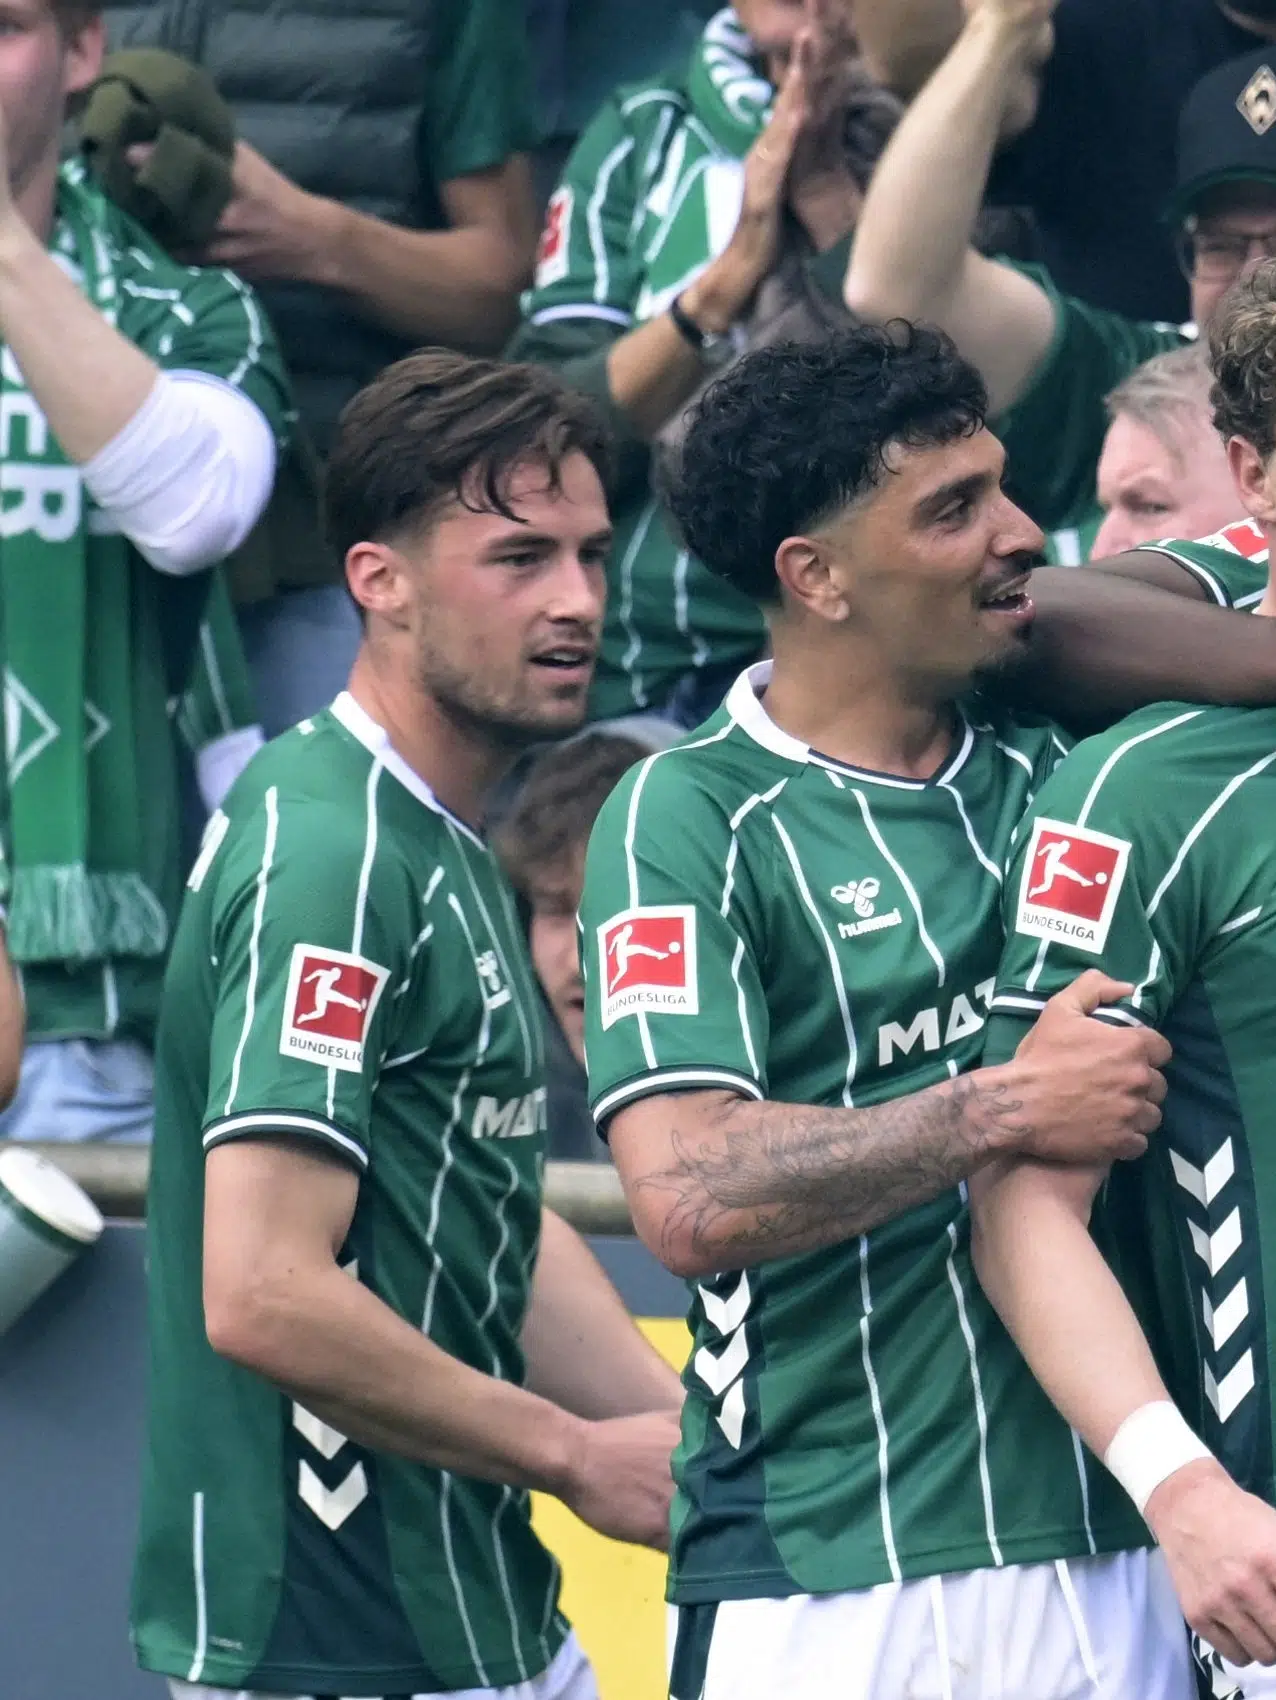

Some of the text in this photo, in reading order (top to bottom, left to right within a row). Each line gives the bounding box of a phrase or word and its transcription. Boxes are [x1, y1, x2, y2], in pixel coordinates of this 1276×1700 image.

[0, 345, 82, 543] ER
[838, 908, 902, 939] hummel
[1022, 911, 1096, 942] BUNDESLIGA
[607, 992, 687, 1016] BUNDESLIGA
